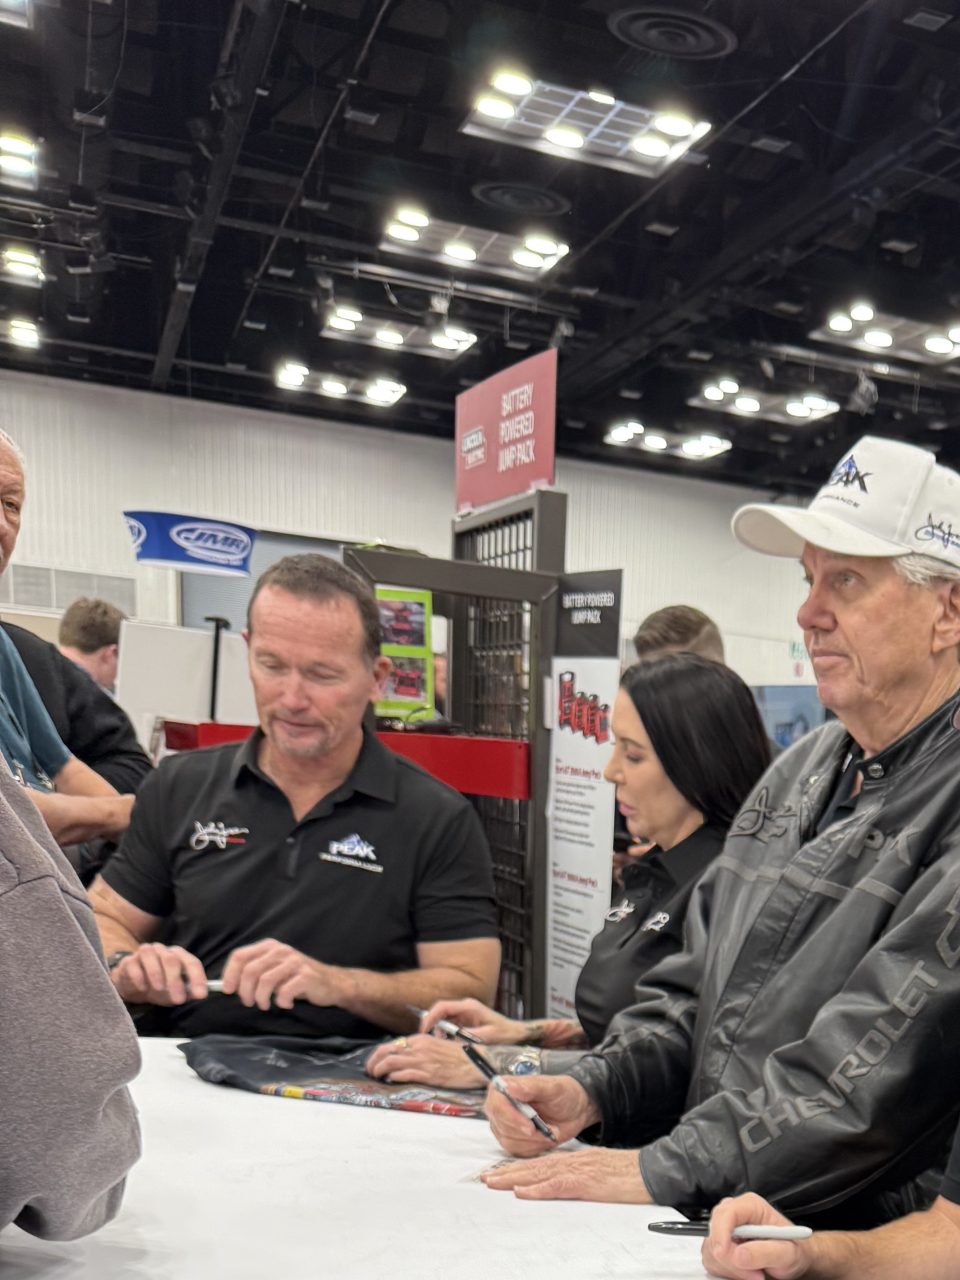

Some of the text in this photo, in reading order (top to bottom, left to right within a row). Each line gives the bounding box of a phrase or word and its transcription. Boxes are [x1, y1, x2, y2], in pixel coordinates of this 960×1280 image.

[500, 383, 534, 417] BATTERY
[499, 411, 535, 445] POWERED
[498, 438, 535, 473] JUMP PACK
[328, 838, 377, 861] PEAK
[738, 960, 938, 1154] CHEVROLET
